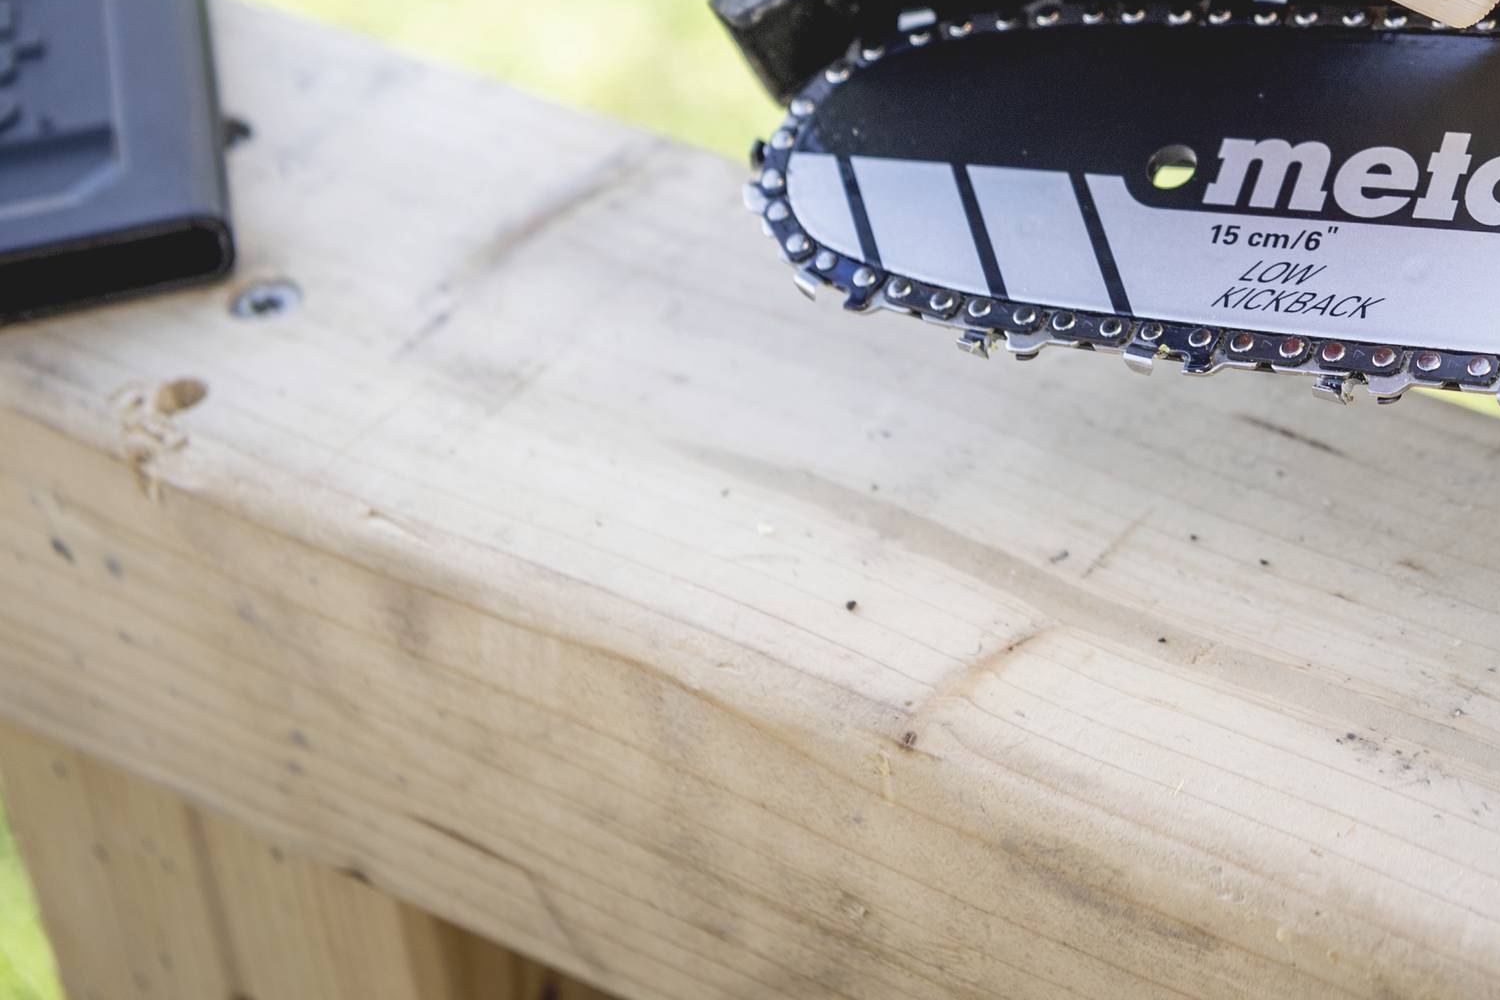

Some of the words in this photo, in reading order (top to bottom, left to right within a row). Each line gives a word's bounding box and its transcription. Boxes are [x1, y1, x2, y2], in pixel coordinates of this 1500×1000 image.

[1211, 224, 1241, 246] 15
[1247, 226, 1339, 251] cm/6"
[1238, 260, 1328, 286] LOW
[1211, 286, 1388, 320] KICKBACK
